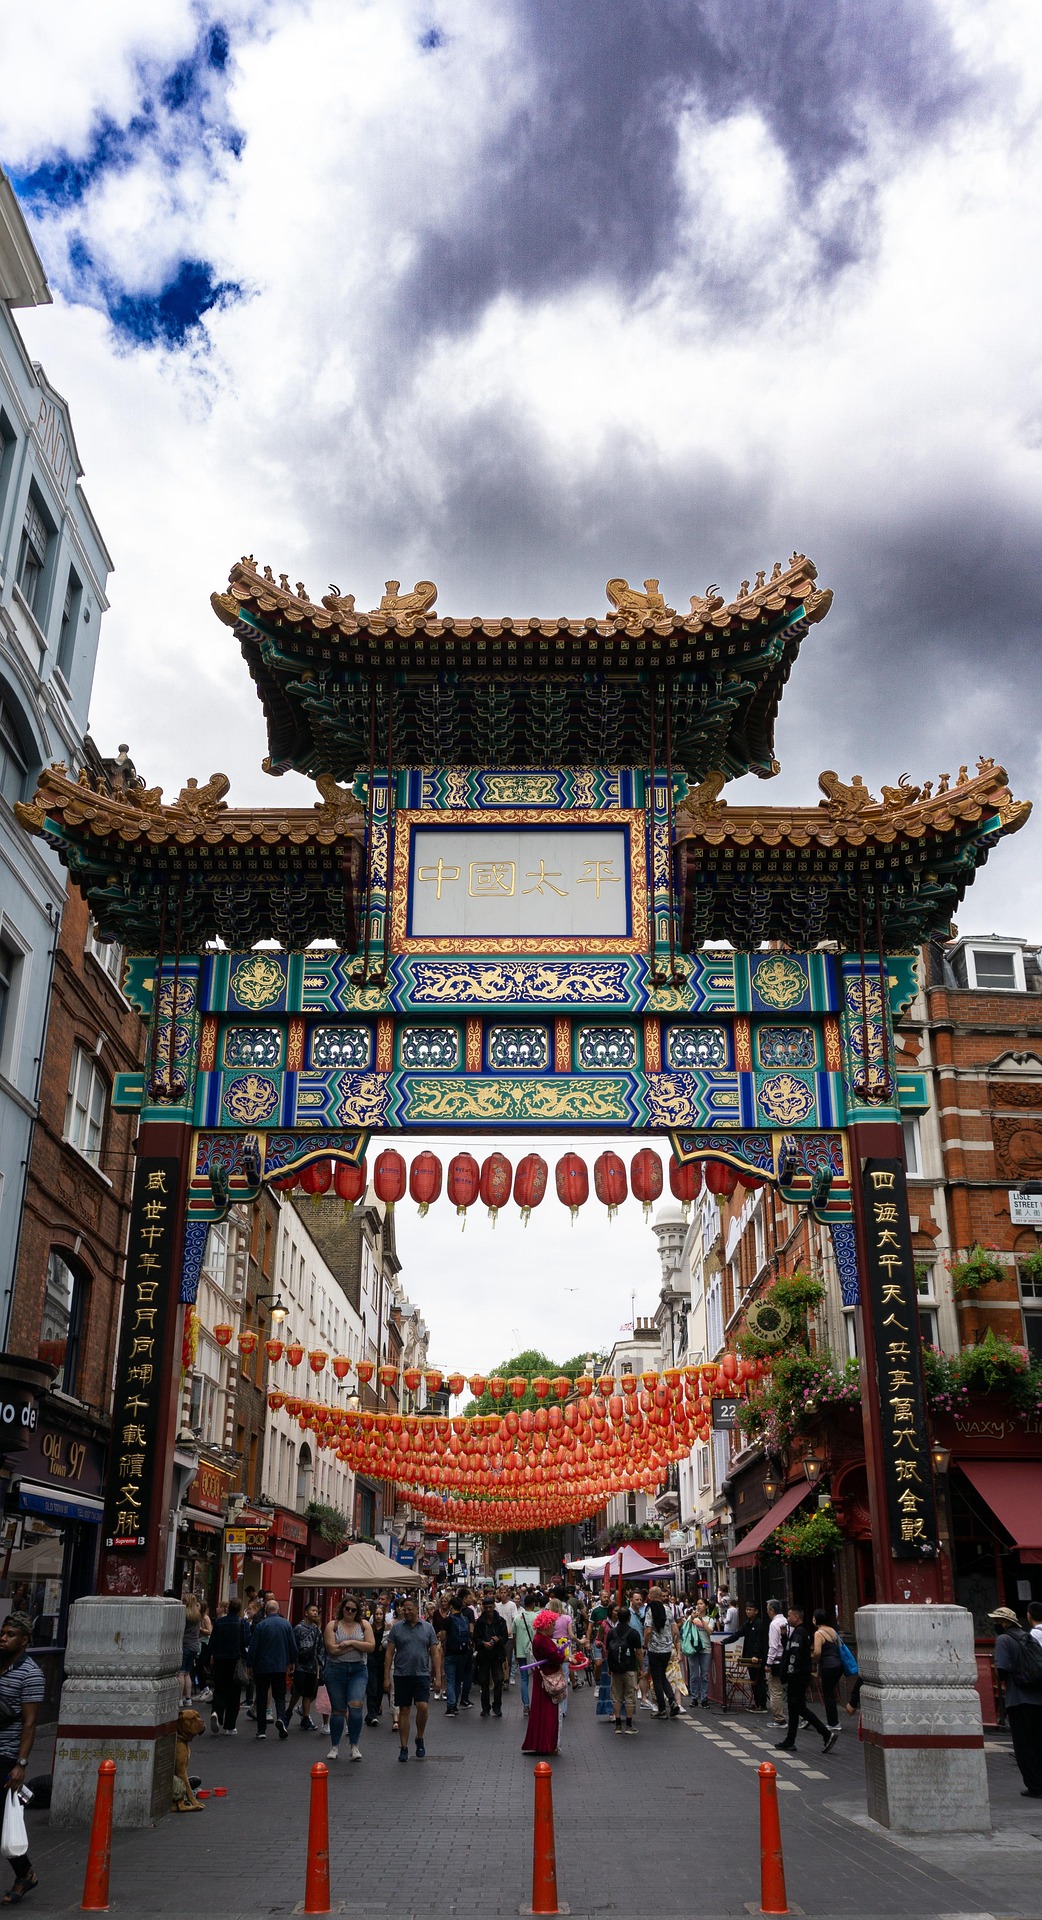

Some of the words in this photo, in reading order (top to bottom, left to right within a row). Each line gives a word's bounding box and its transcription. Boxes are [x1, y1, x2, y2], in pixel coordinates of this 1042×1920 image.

[418, 857, 622, 900] 中國太平
[21, 1401, 36, 1429] de
[720, 1405, 736, 1417] 22
[43, 1434, 62, 1459] Old
[49, 1457, 67, 1478] Town
[68, 1442, 87, 1480] 97
